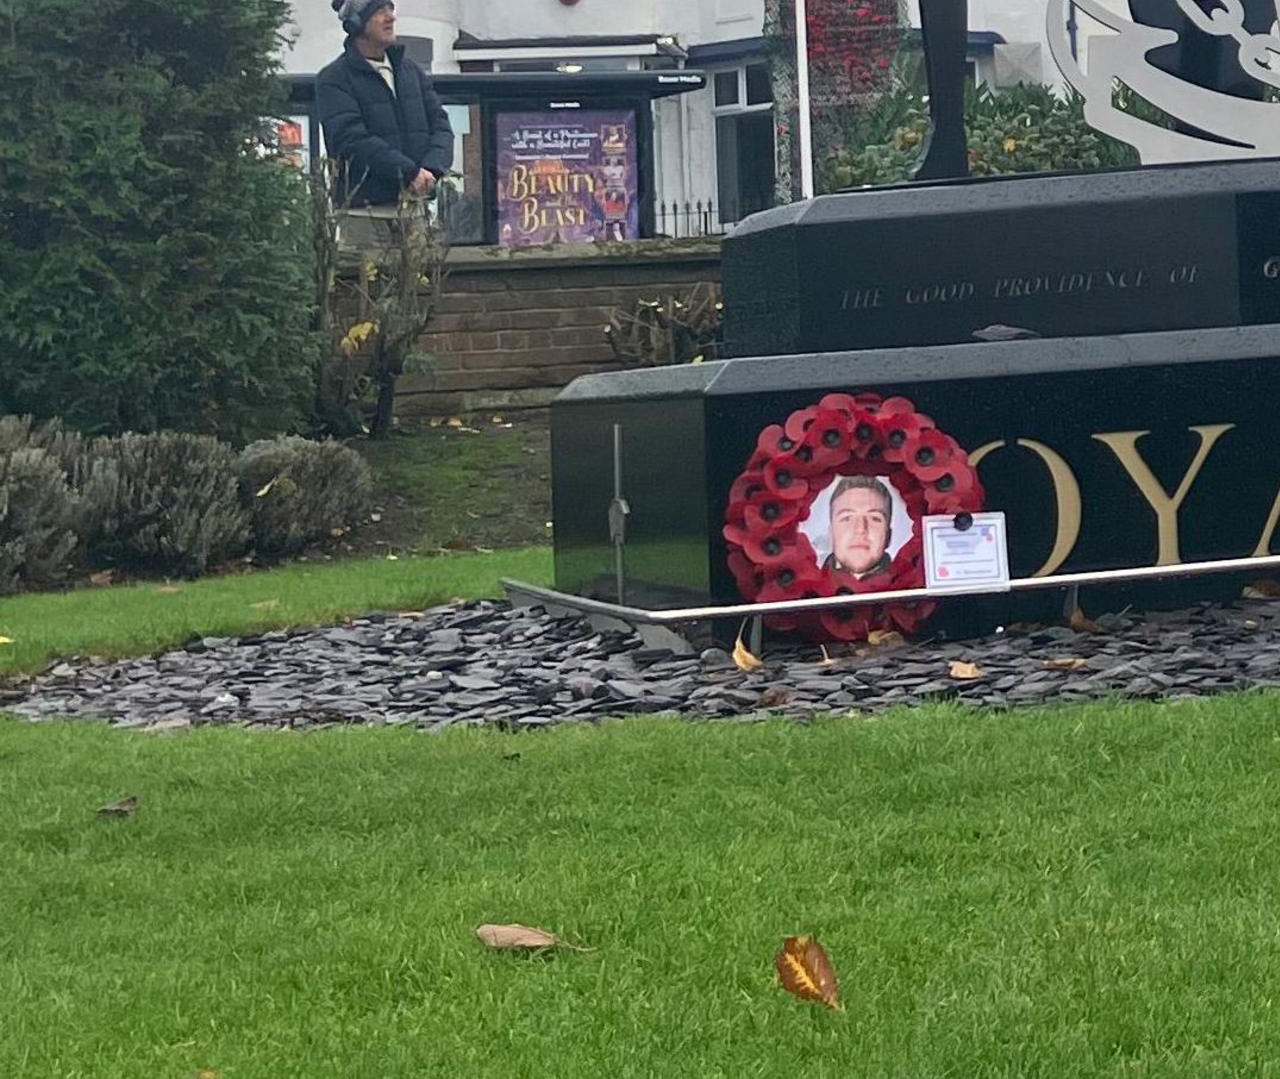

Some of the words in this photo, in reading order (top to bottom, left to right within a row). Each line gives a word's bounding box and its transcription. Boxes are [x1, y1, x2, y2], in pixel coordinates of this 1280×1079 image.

[508, 164, 595, 201] BEAUTY
[520, 197, 588, 234] BEAST
[840, 289, 882, 310] THE
[905, 282, 975, 305] GOOD
[993, 267, 1149, 299] PROVIDENCE
[1170, 264, 1199, 284] OF
